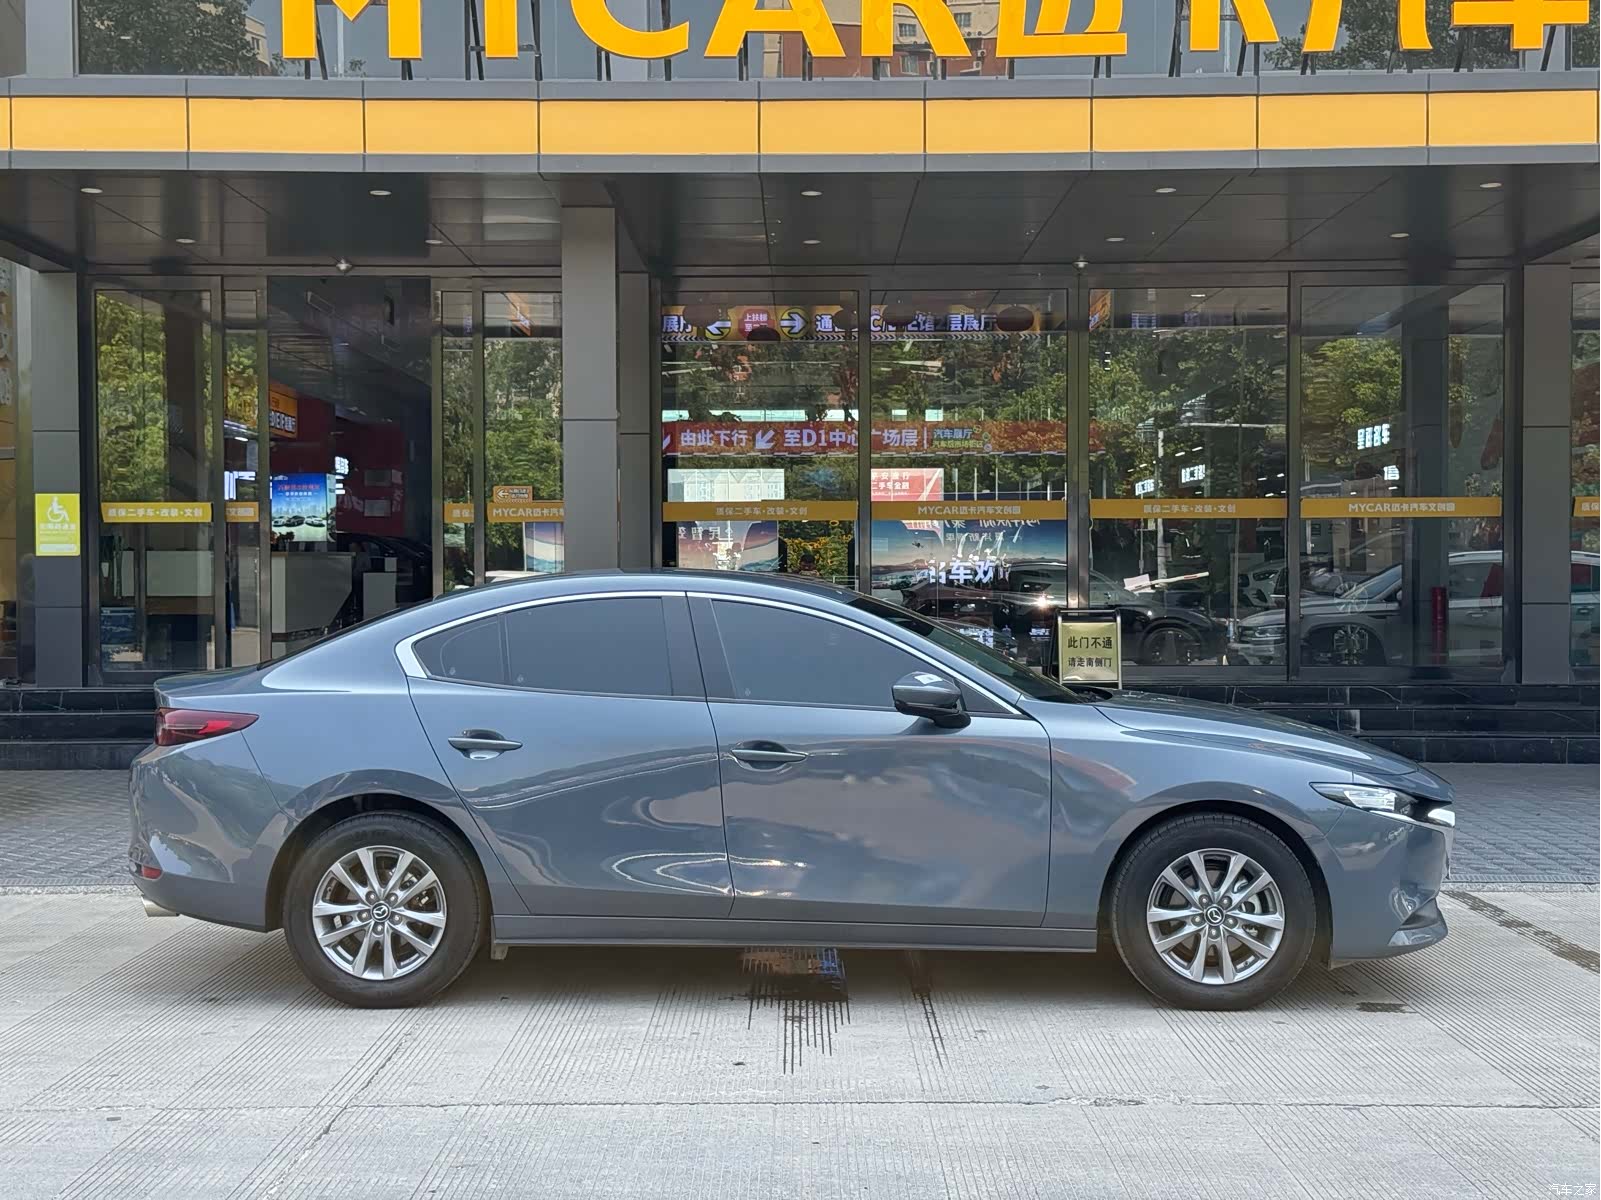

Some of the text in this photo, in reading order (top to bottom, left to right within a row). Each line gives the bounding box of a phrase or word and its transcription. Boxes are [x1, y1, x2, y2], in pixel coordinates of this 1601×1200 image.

[680, 429, 749, 447] 由此下行
[1067, 636, 1113, 650] 此门不通
[1068, 657, 1112, 668] 请走南侧门
